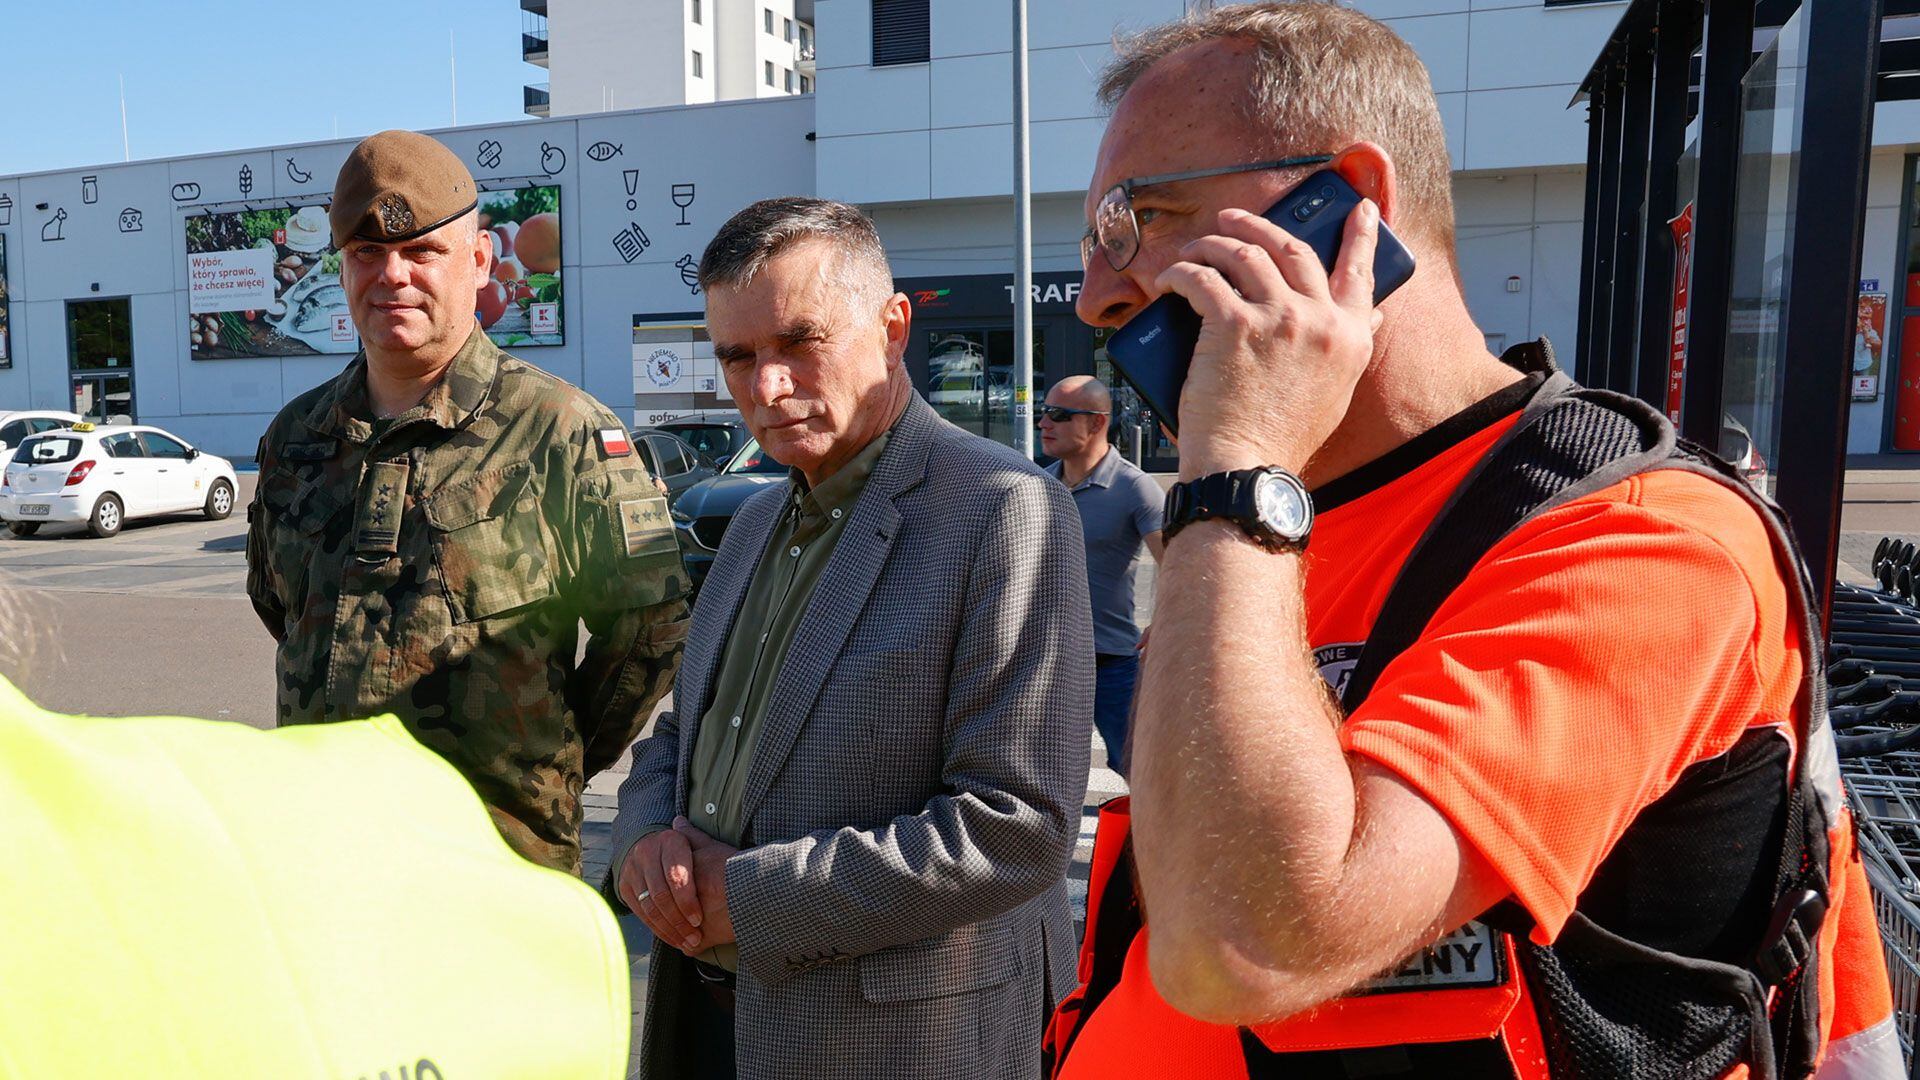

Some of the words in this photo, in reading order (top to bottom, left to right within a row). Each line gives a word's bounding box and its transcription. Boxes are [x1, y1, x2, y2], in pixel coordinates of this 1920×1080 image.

[192, 257, 224, 269] Wybór,
[192, 270, 216, 280] który
[218, 266, 256, 277] sprawia,
[193, 282, 203, 291] że
[205, 281, 234, 290] chcesz
[236, 277, 265, 289] więcej
[1139, 325, 1162, 345] Redmi
